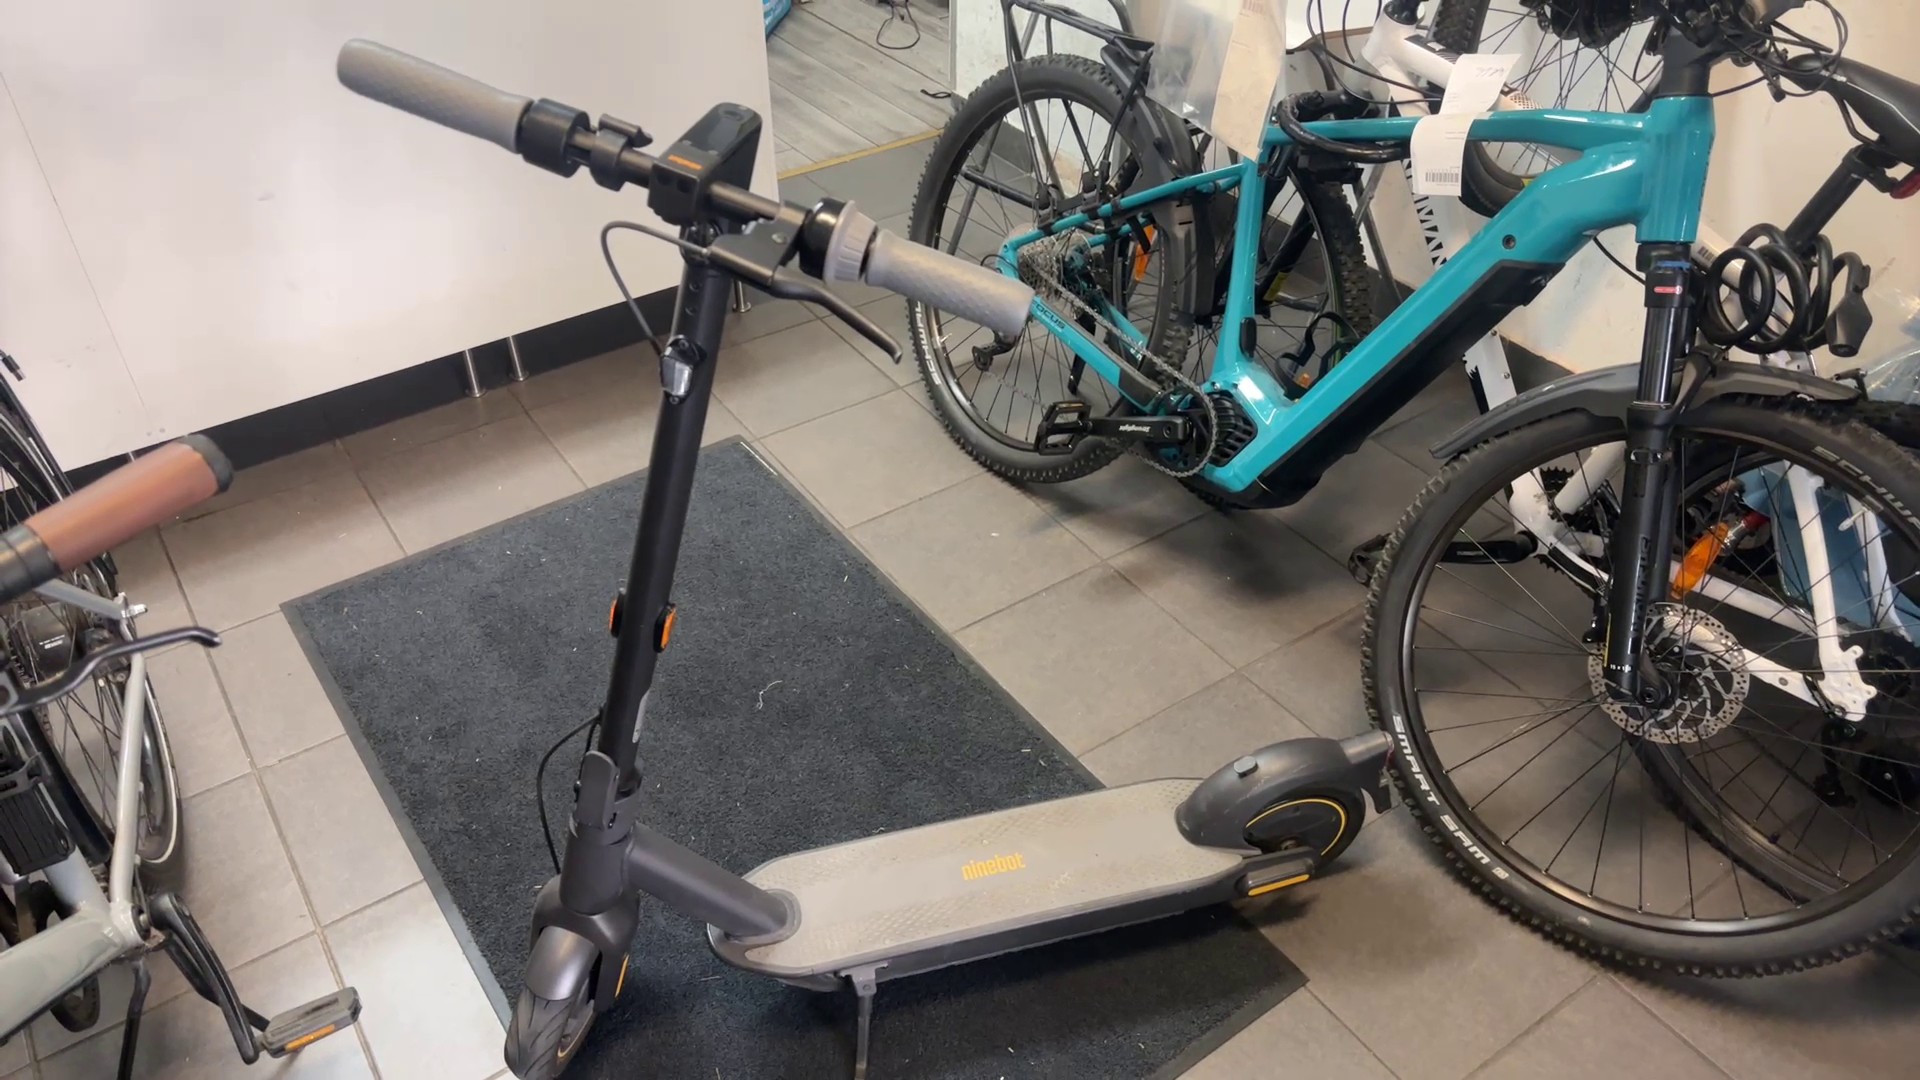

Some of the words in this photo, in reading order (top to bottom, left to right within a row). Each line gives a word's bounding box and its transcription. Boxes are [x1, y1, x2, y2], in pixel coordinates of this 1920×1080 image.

[914, 301, 942, 386] SCHWAL
[1393, 715, 1440, 806] SMART
[1440, 814, 1491, 865] SAM
[961, 852, 1026, 881] ninebot
